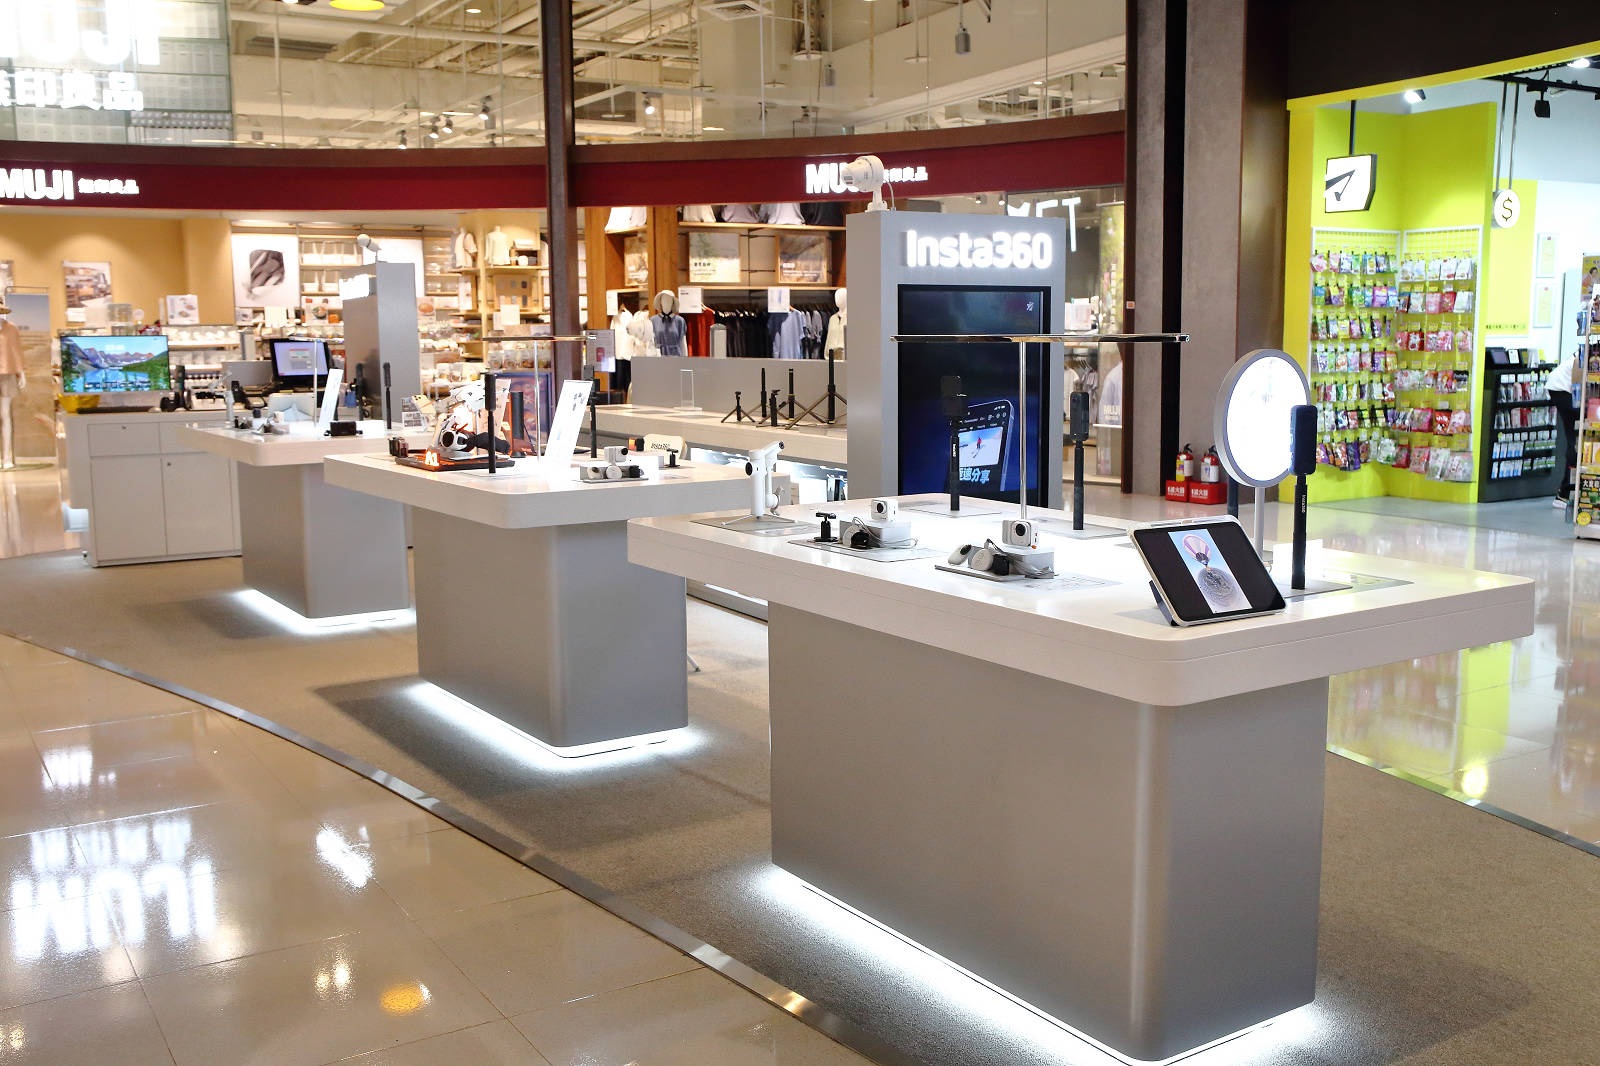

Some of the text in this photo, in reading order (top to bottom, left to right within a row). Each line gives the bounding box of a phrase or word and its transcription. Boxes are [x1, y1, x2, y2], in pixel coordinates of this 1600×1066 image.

[0, 0, 160, 66] UJI
[0, 69, 145, 112] 印良品
[0, 168, 75, 201] MUJI
[805, 162, 860, 194] MU
[905, 229, 1053, 270] Insta360
